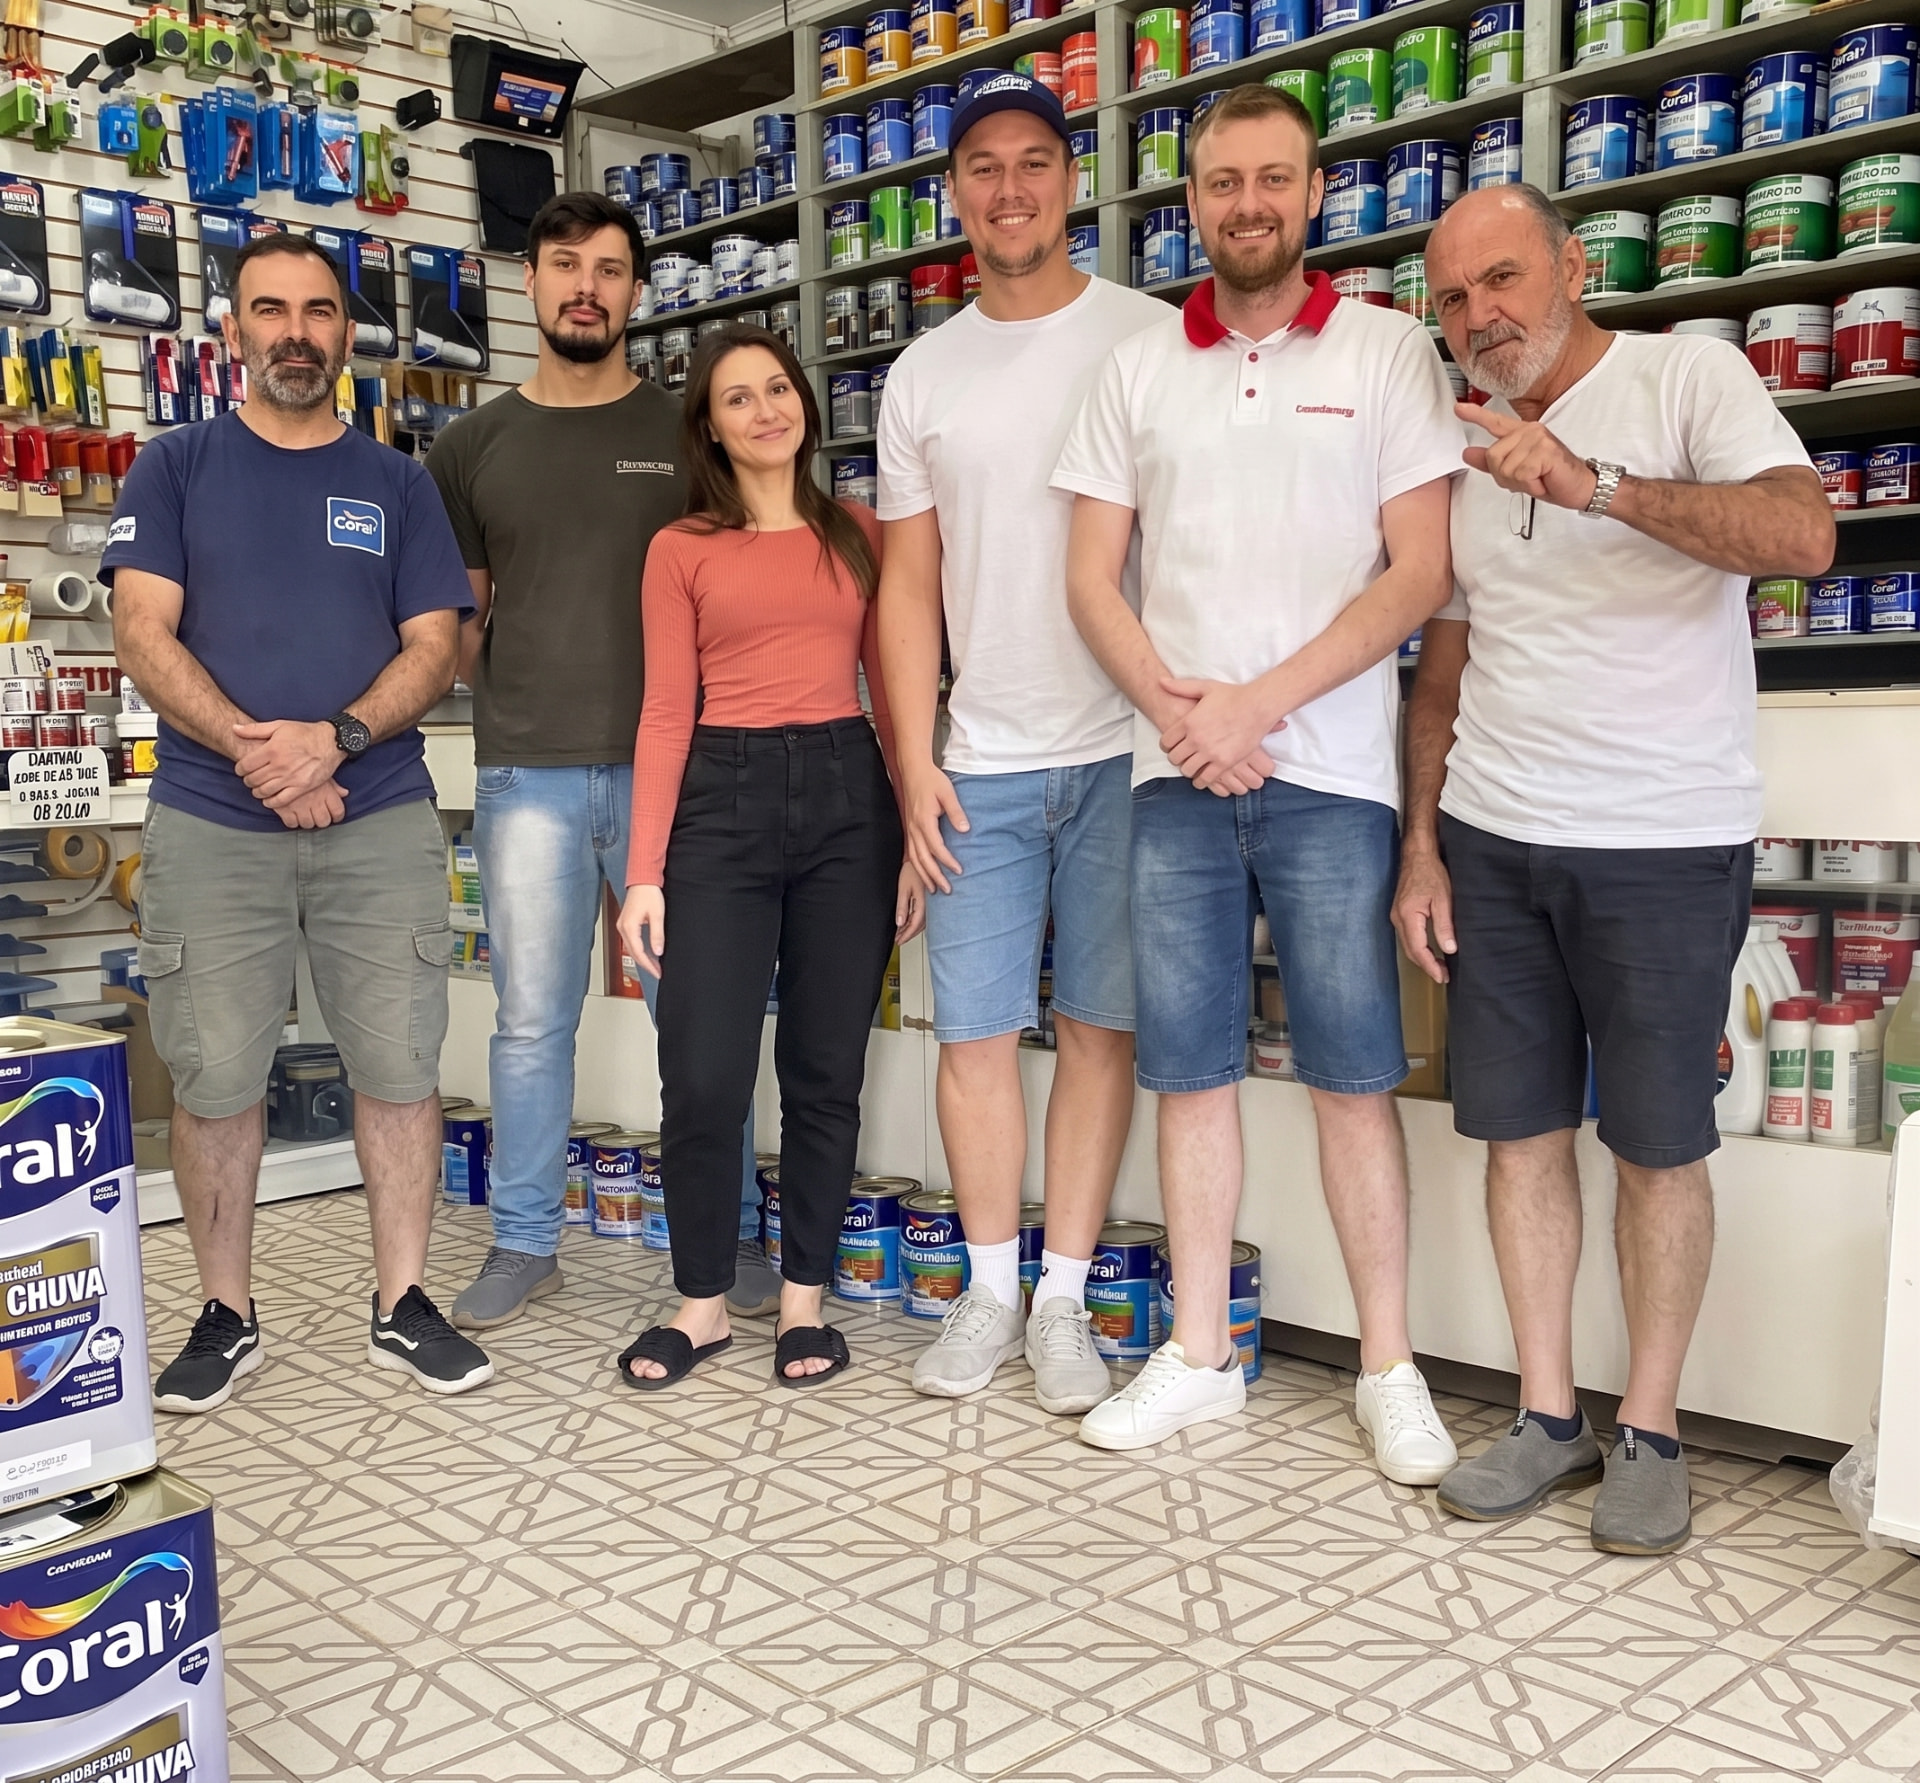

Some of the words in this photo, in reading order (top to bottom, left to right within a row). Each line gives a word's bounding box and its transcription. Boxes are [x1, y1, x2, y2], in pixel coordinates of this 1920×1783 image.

[1660, 93, 1693, 111] Coral
[1472, 135, 1502, 152] Coral
[333, 515, 373, 535] Coral
[595, 1159, 628, 1174] Coral
[842, 1213, 867, 1228] oral
[905, 1224, 944, 1243] Coral
[1089, 1262, 1115, 1279] oral
[6, 1266, 107, 1317] CHUVA
